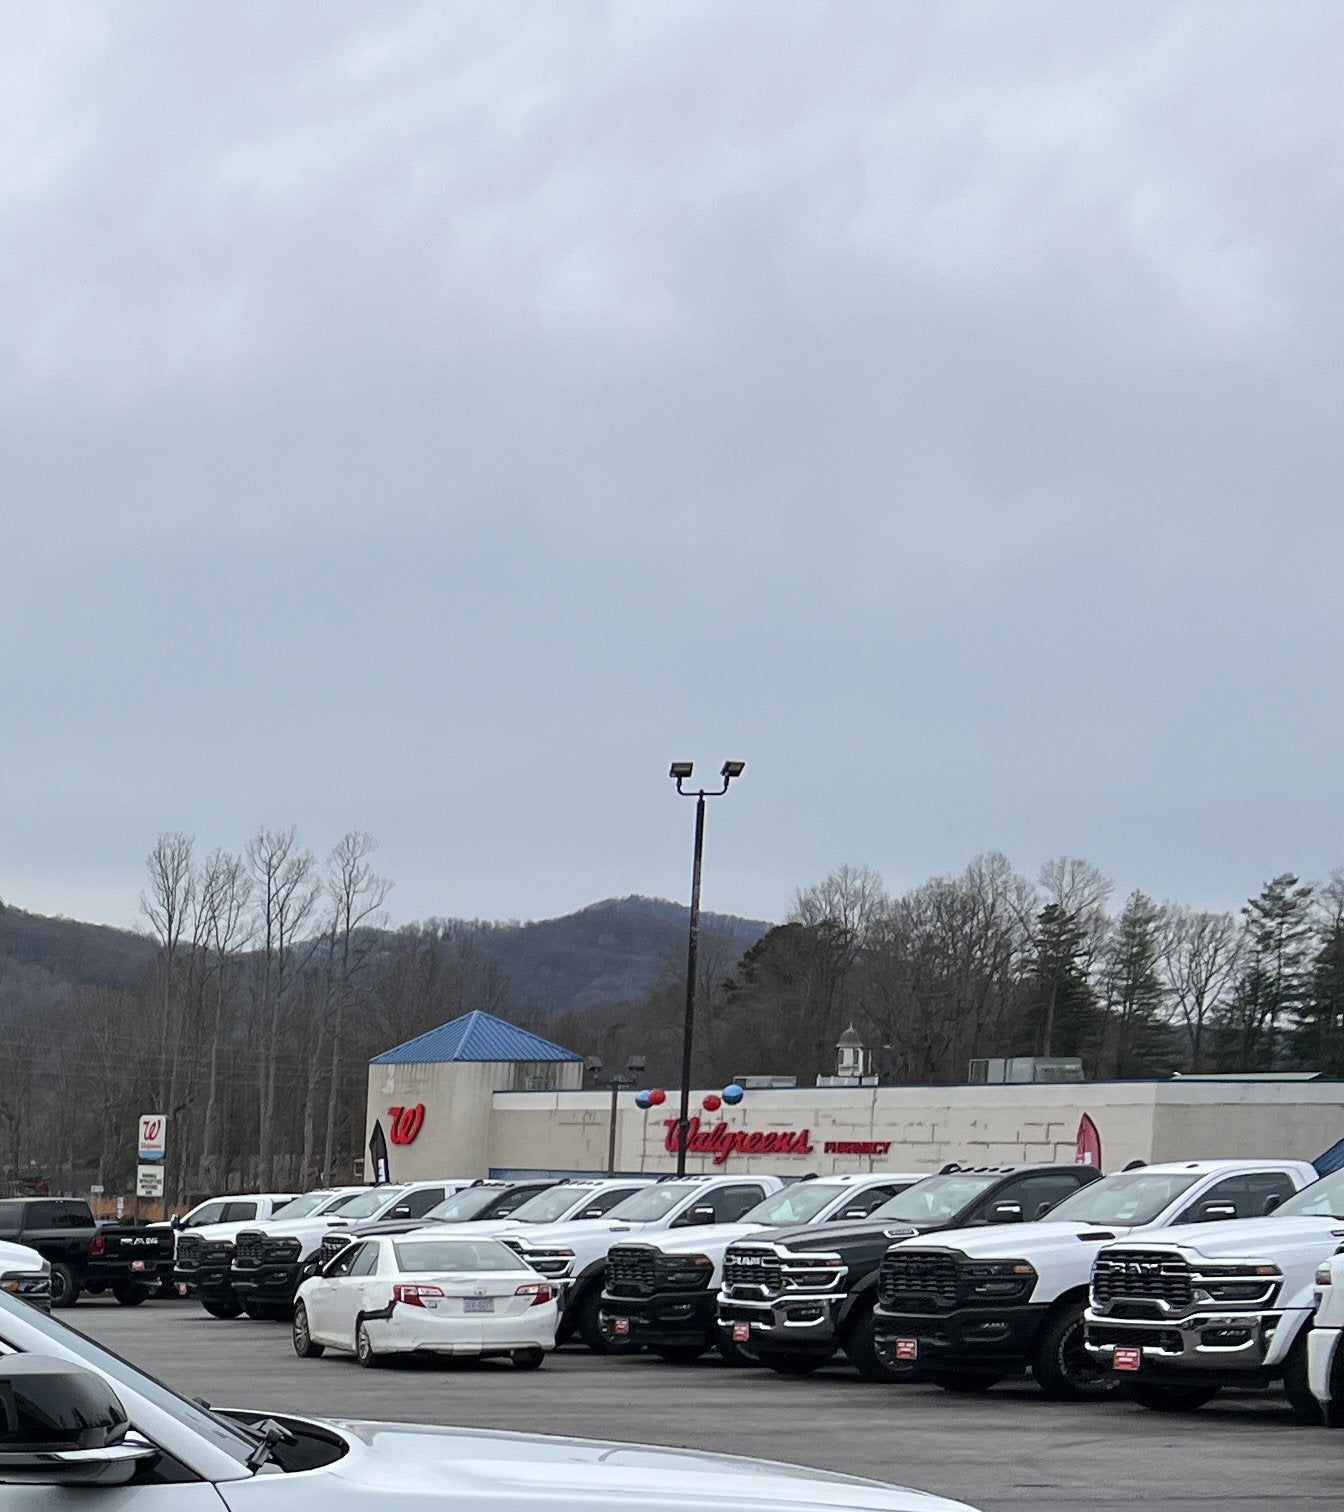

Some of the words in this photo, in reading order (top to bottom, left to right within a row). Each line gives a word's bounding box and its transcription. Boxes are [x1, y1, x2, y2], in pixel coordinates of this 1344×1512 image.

[143, 1119, 162, 1141] W
[388, 1103, 425, 1145] W
[664, 1116, 813, 1165] Walgreens
